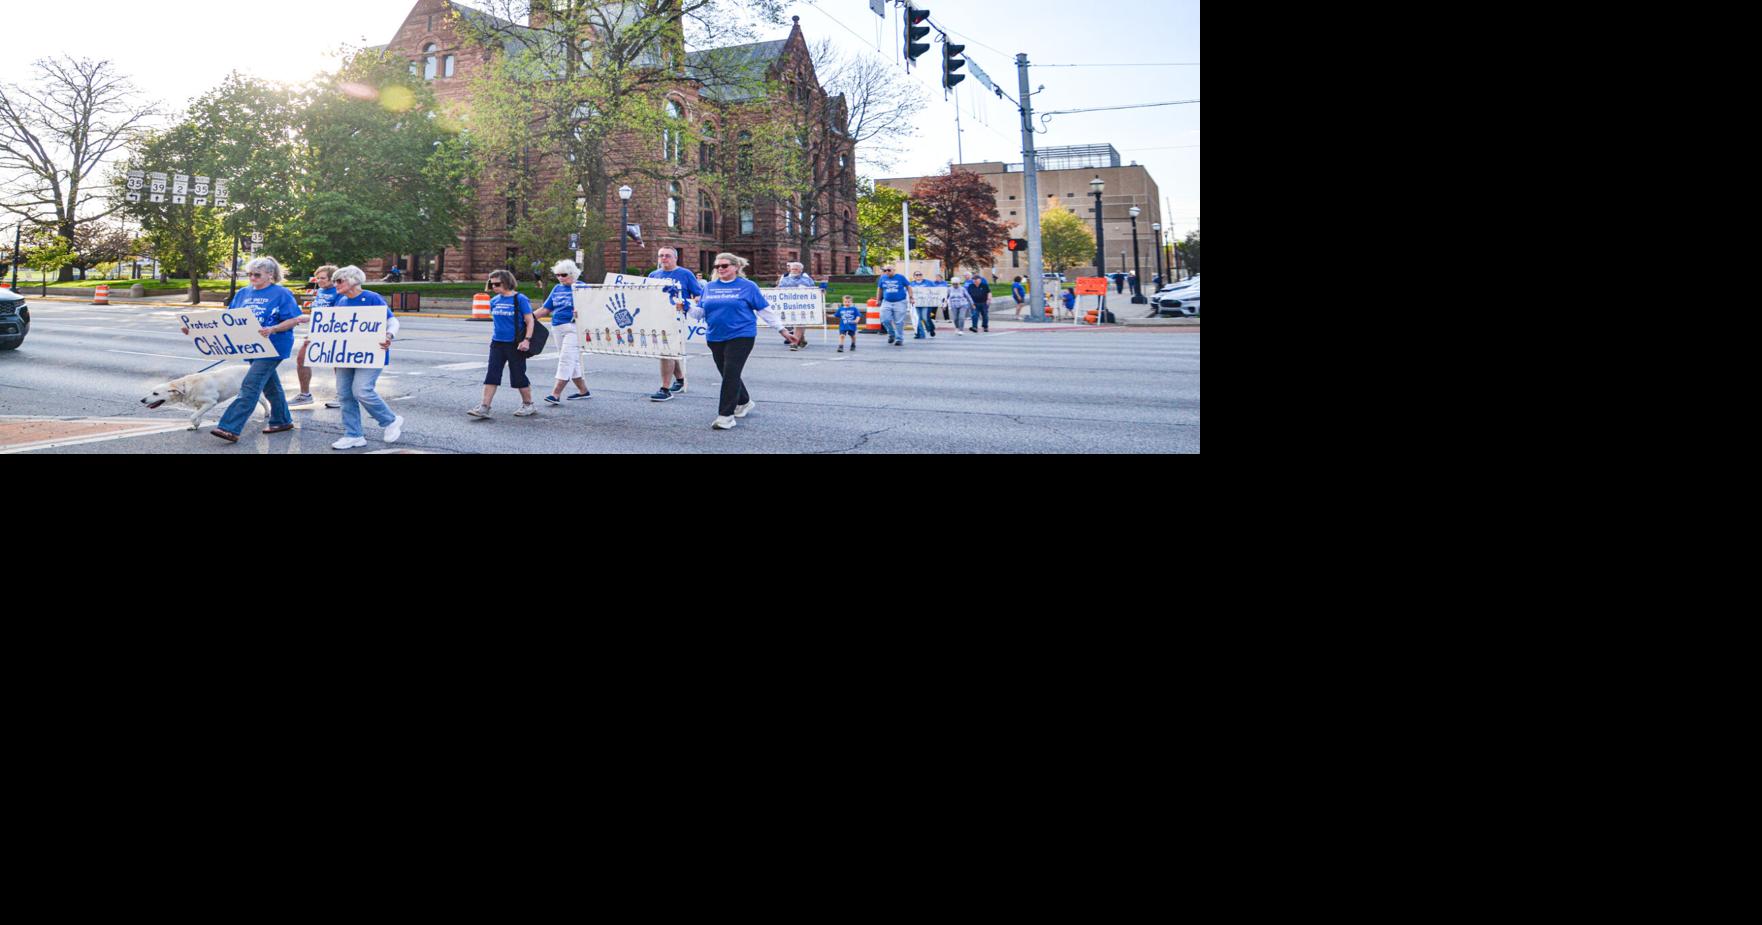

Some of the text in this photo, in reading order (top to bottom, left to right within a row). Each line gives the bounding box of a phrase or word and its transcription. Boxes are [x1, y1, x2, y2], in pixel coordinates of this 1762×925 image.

[128, 179, 142, 188] 35
[152, 183, 165, 192] 39
[177, 185, 184, 194] 2
[195, 185, 208, 194] 35
[217, 189, 228, 197] 39
[252, 233, 263, 241] 35
[779, 292, 808, 300] Children
[810, 292, 817, 300] is
[783, 302, 815, 310] Business
[181, 315, 219, 329] Protect
[222, 313, 248, 326] Our
[310, 311, 382, 333] Protect our
[194, 333, 265, 355] Children
[308, 339, 374, 364] Children
